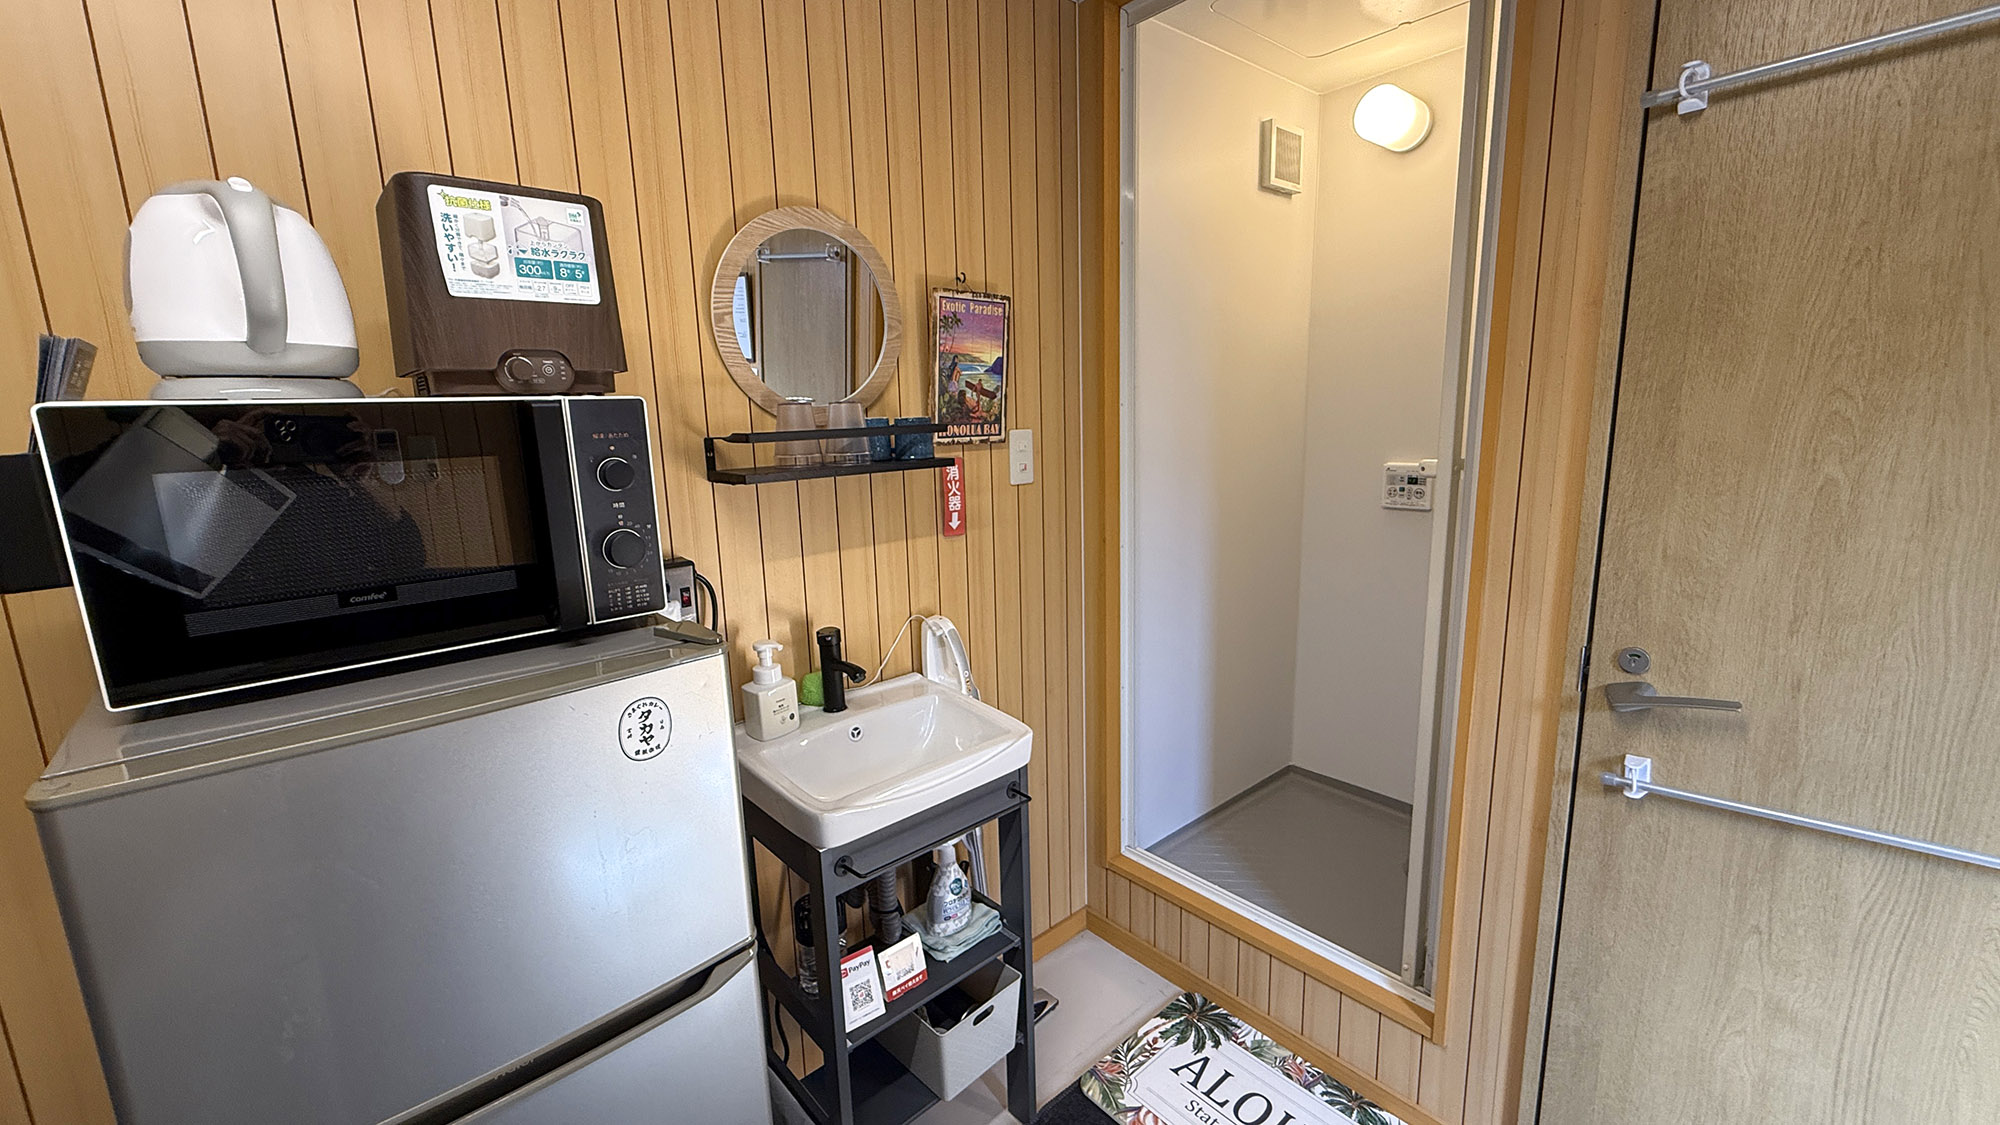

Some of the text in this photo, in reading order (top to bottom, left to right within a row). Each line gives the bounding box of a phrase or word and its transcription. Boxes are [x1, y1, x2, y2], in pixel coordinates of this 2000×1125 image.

[530, 246, 586, 260] 給水ラクラク
[942, 300, 1003, 316] Exotic Paradise
[983, 423, 1000, 435] BAY
[946, 465, 961, 511] 消火器
[638, 709, 655, 746] タカヤ
[848, 959, 871, 973] PayPay
